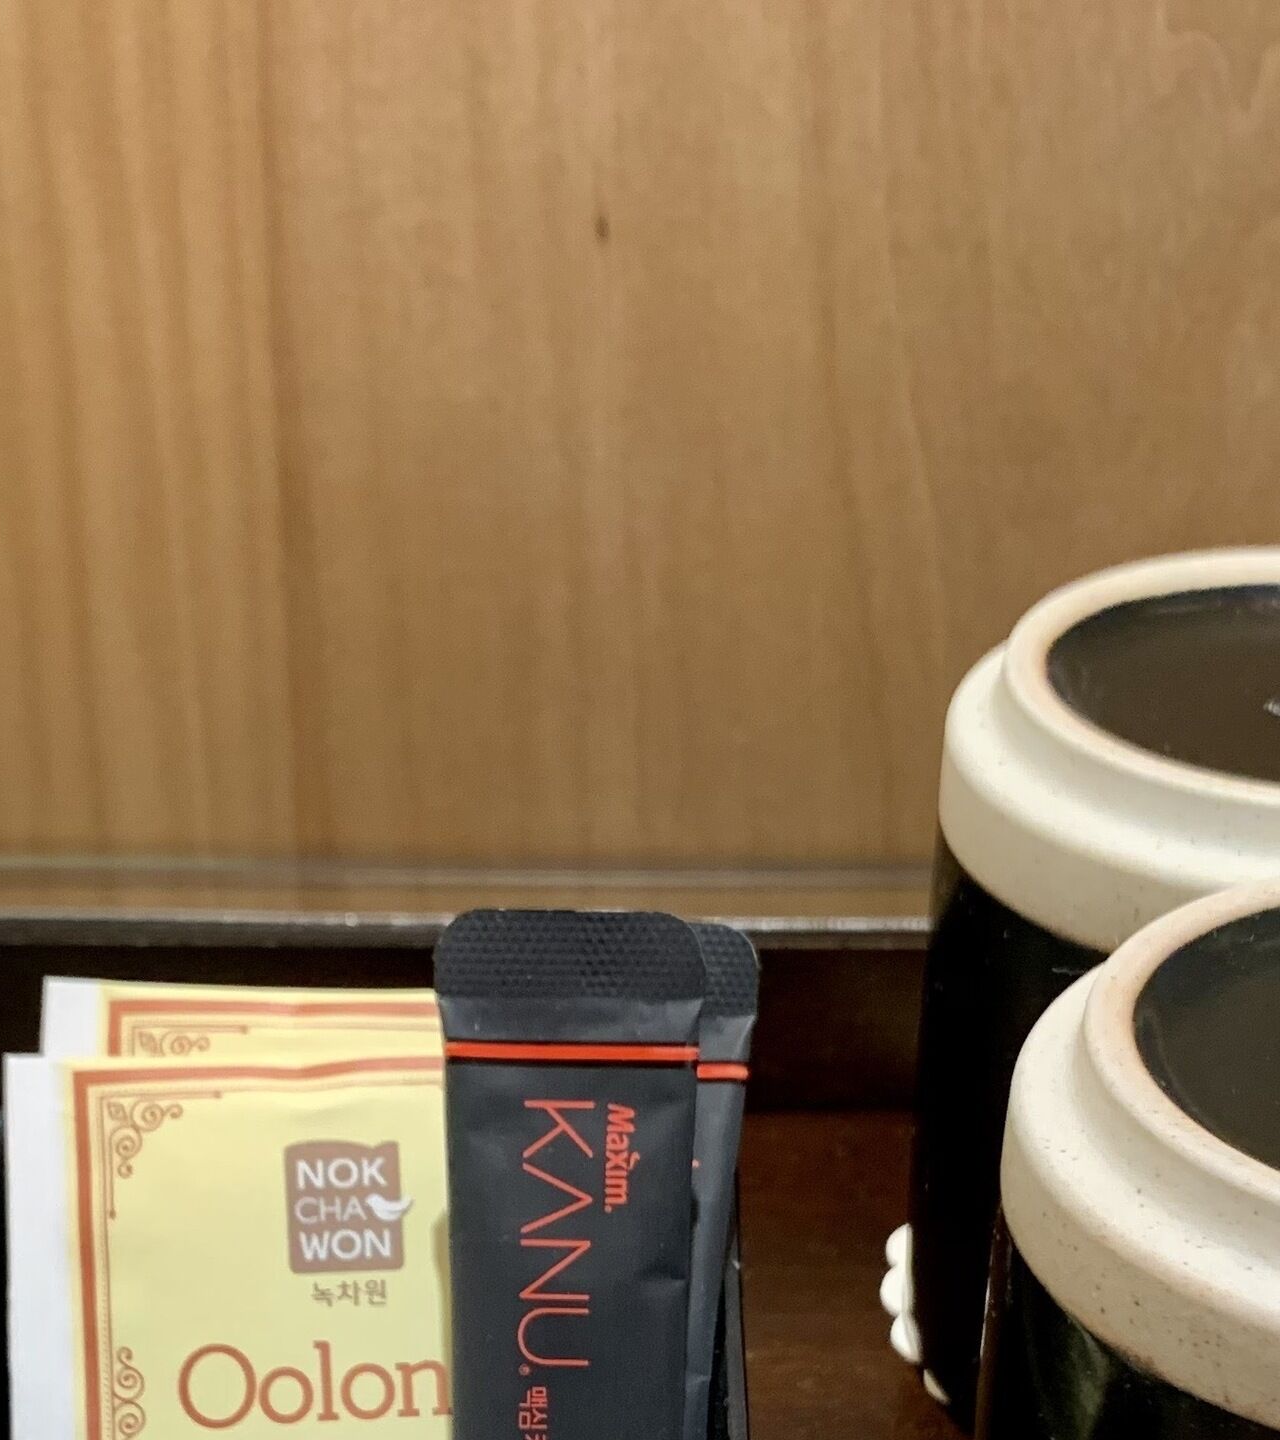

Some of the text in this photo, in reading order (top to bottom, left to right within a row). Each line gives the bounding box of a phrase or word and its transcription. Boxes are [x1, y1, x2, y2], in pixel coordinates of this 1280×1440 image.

[605, 1103, 638, 1207] Maxim
[296, 1157, 387, 1190] NOK
[294, 1196, 367, 1225] CHA
[299, 1228, 392, 1262] WON
[517, 1099, 596, 1369] KANU
[311, 1279, 386, 1307] 녹차원
[178, 1340, 453, 1429] Oolon
